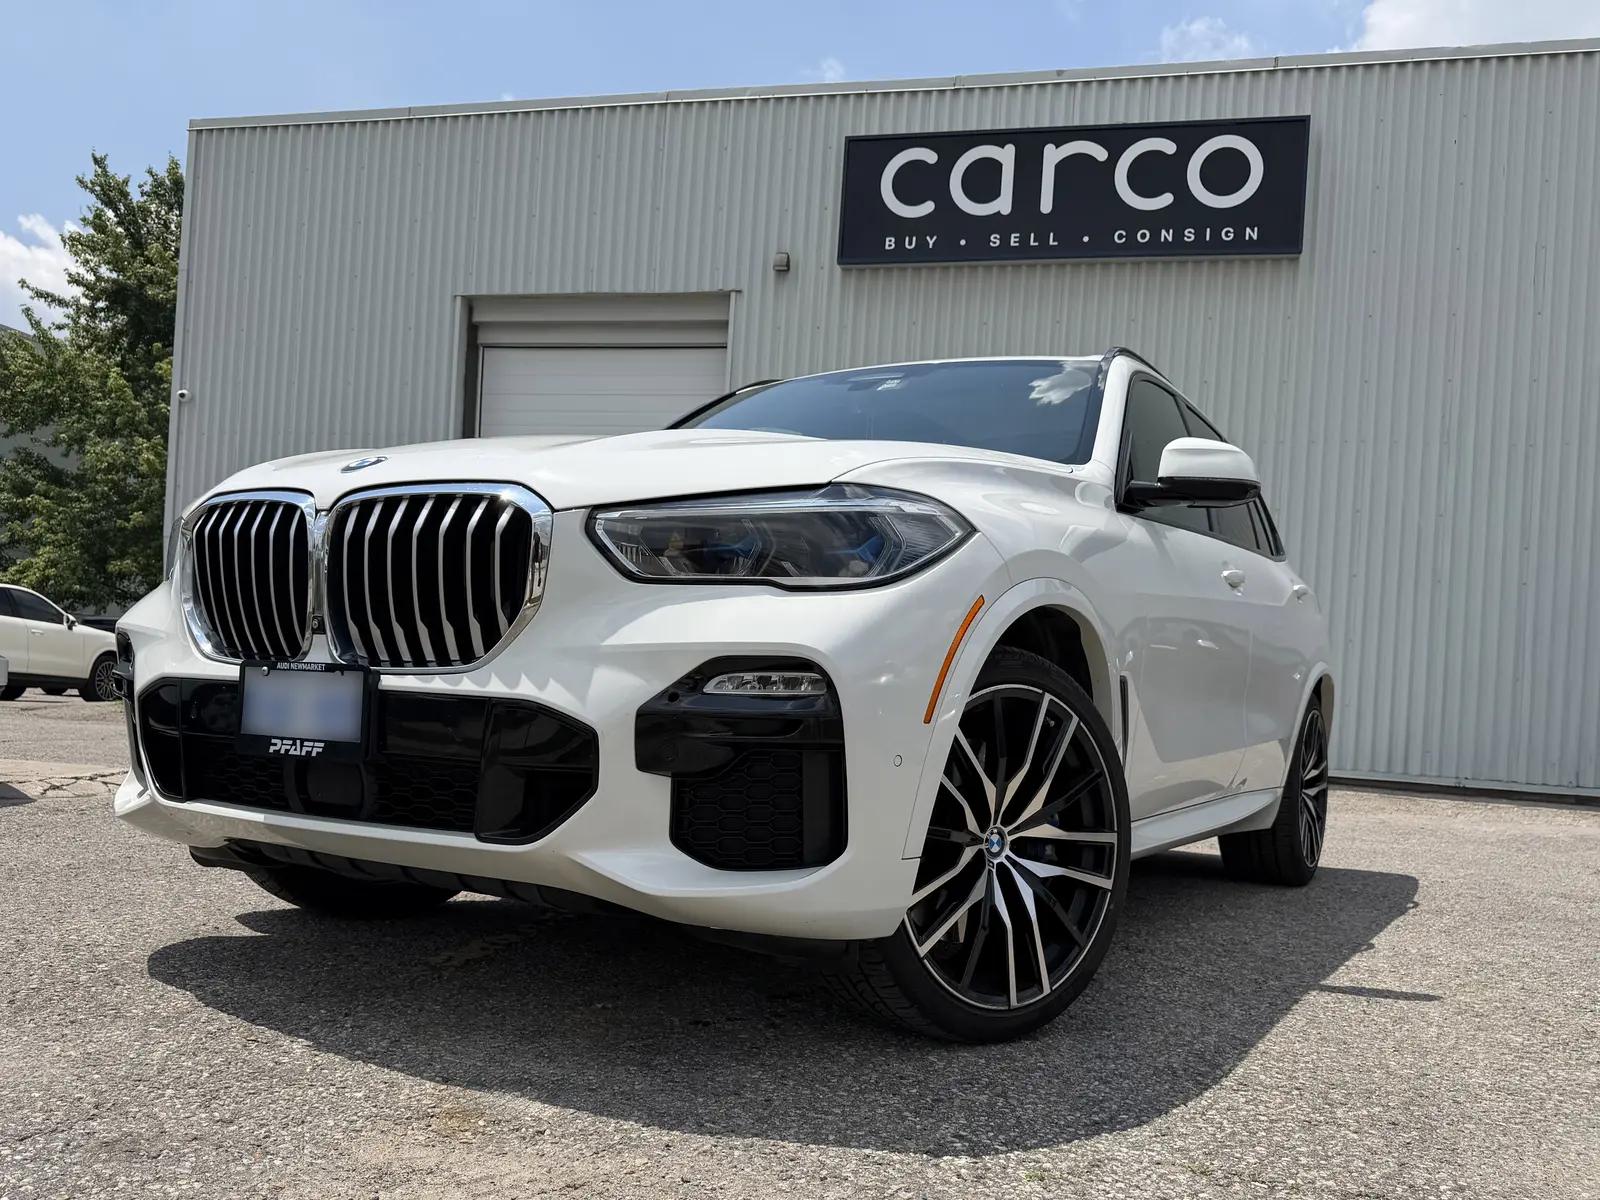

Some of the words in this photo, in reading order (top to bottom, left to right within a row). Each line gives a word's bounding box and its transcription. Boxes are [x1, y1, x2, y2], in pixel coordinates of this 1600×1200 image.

[880, 134, 1264, 219] carco
[884, 236, 938, 250] BUY
[989, 232, 1059, 248] SELL
[1113, 226, 1259, 244] CONSIGN
[276, 662, 290, 670] AUDI
[290, 662, 326, 671] NEWMARKET
[268, 738, 325, 757] PFAFF
